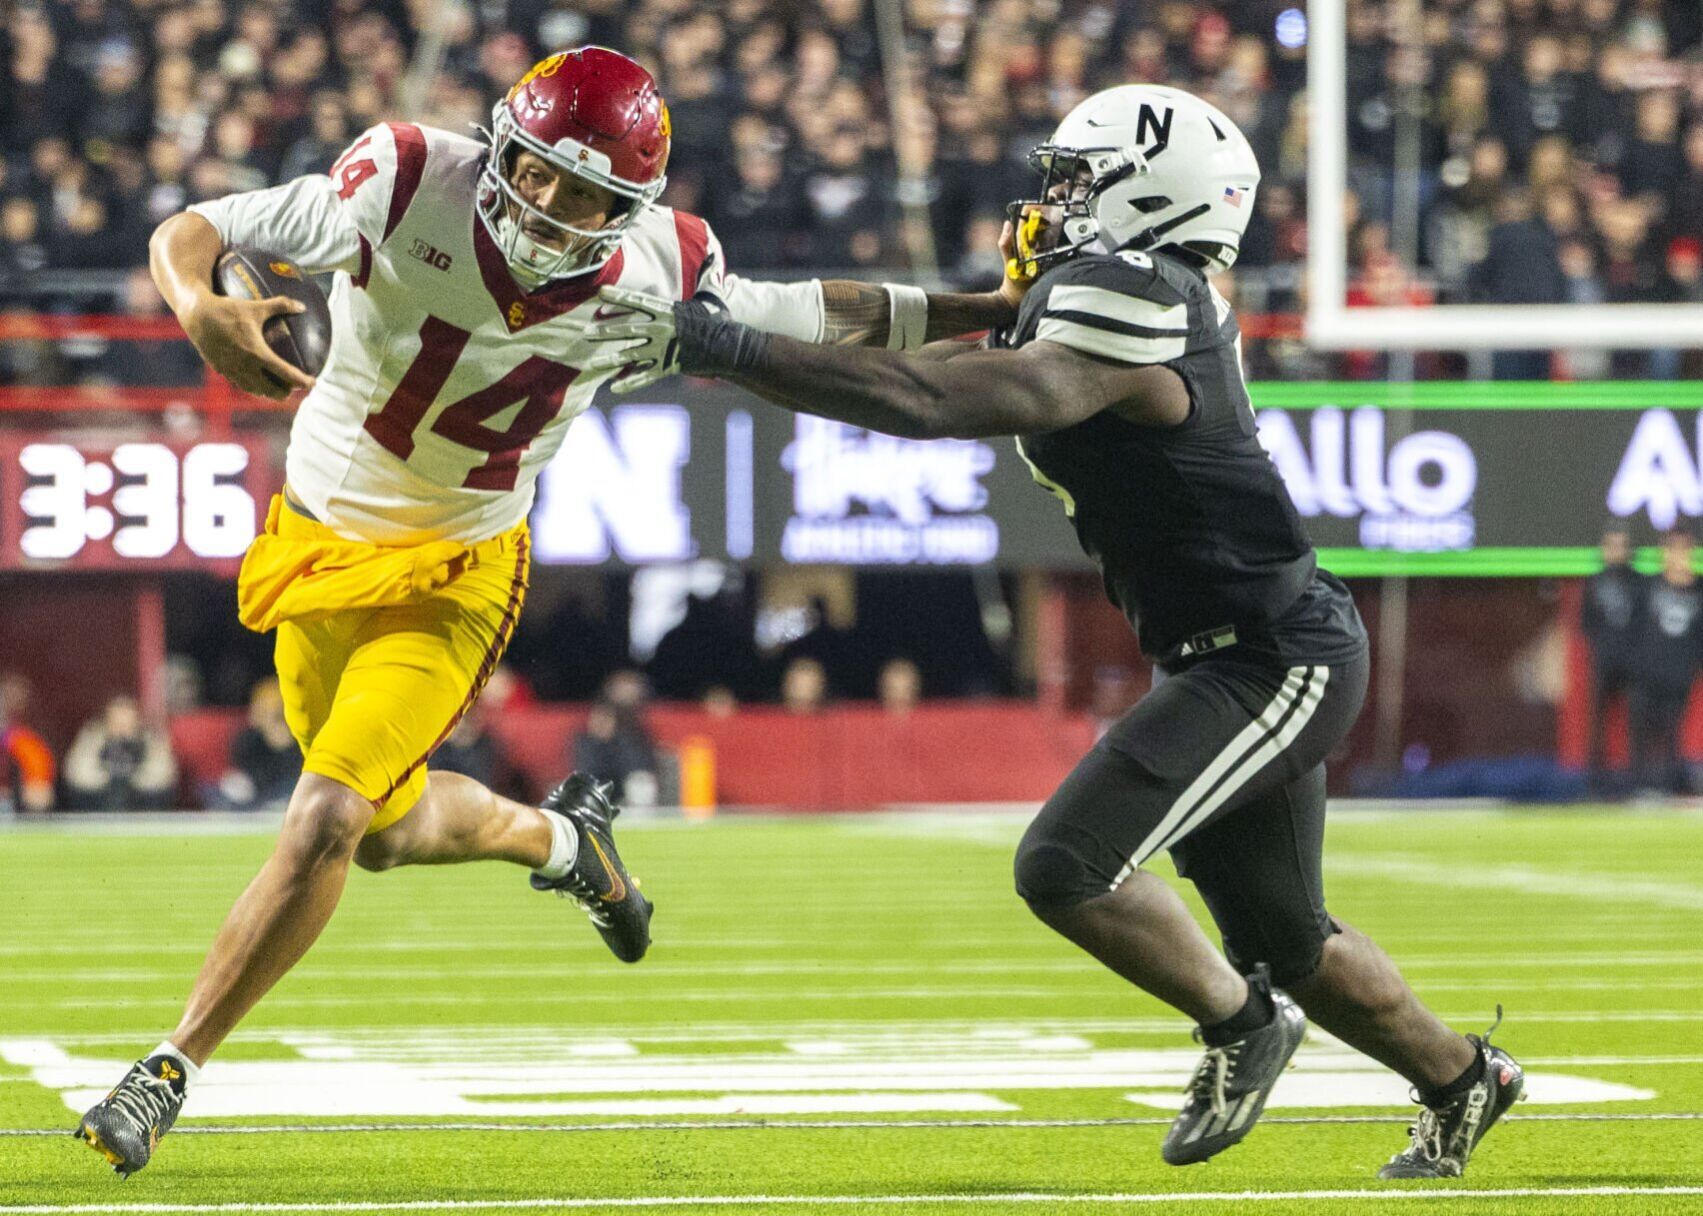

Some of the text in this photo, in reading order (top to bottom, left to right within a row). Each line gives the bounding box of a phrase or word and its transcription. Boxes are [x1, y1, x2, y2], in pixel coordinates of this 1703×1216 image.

[329, 136, 379, 201] 14
[1136, 103, 1174, 150] N
[363, 314, 581, 492] 14
[18, 442, 256, 558] 3:36
[531, 404, 692, 565] N
[1606, 407, 1703, 531] A
